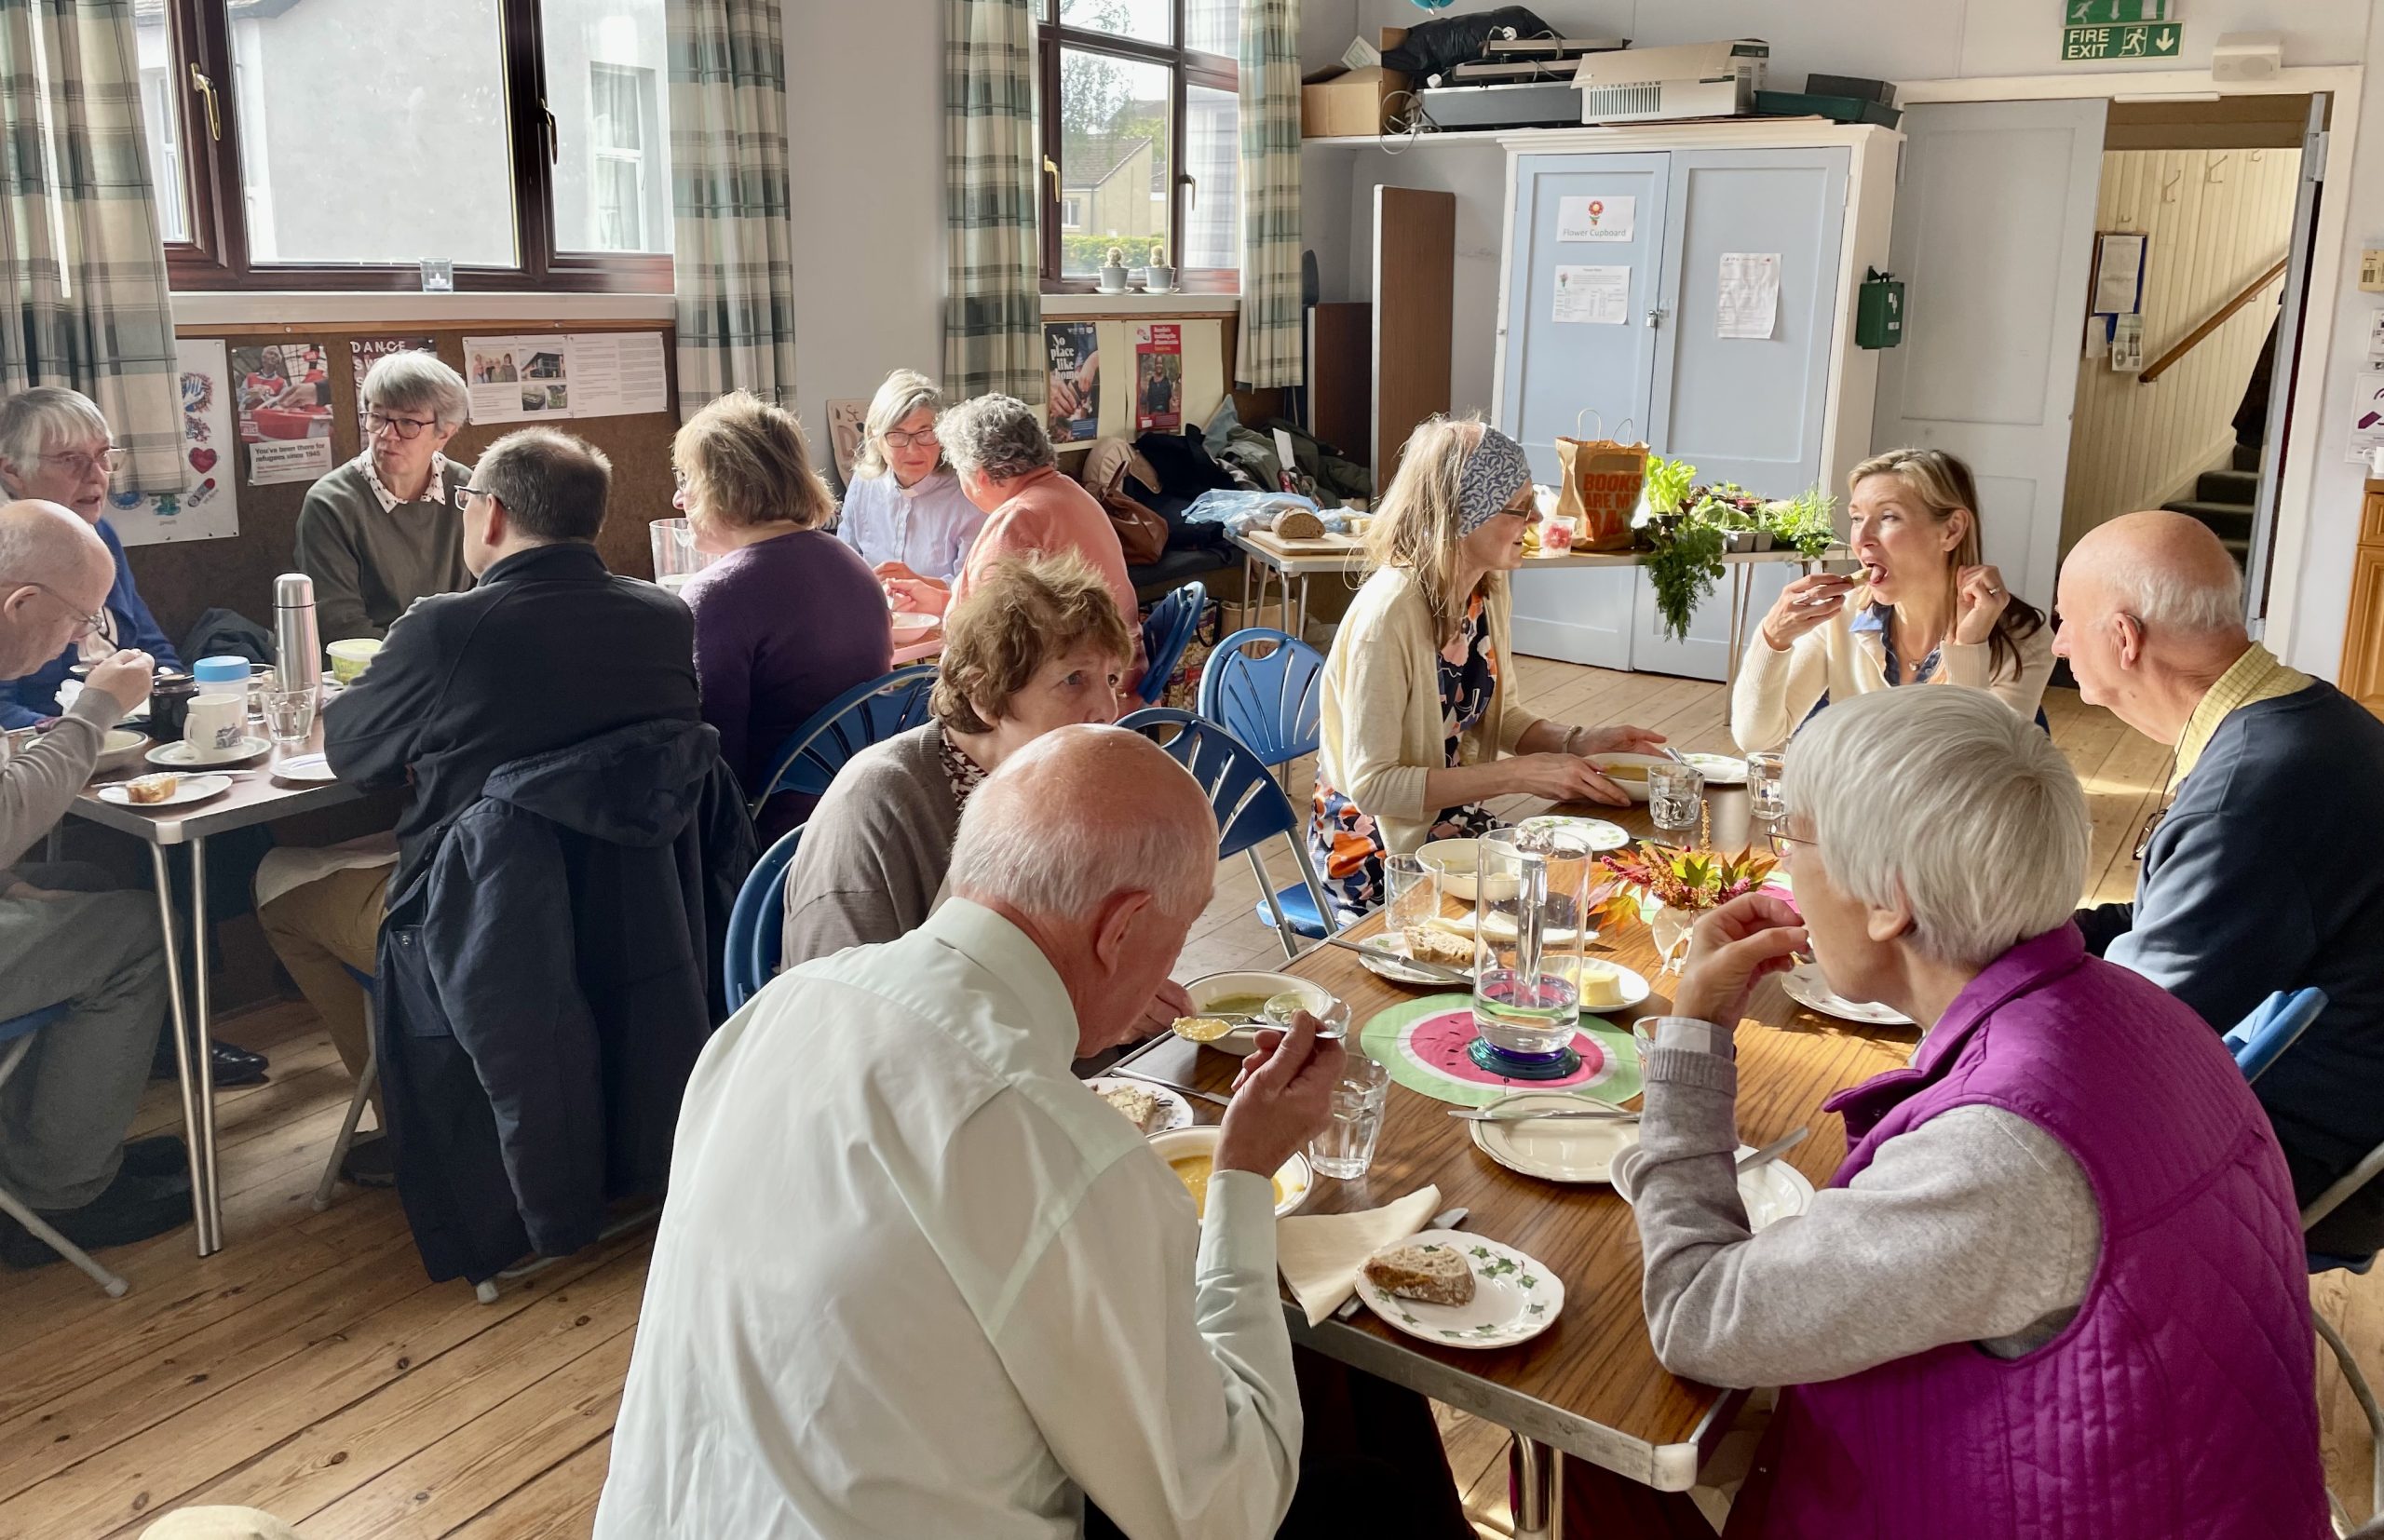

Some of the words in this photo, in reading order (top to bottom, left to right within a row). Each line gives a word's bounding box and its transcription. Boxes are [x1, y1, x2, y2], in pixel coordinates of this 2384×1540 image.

[2069, 28, 2110, 44] FIRE
[2067, 43, 2109, 59] EXIT
[1563, 228, 1588, 237] Flower
[1589, 228, 1627, 238] Cupboard
[351, 340, 406, 354] DANCE
[1050, 345, 1074, 360] place
[1056, 358, 1075, 371] like
[254, 447, 278, 455] You've
[256, 453, 285, 463] refugees
[1584, 473, 1643, 492] BOOKS
[1584, 492, 1612, 509] ARE
